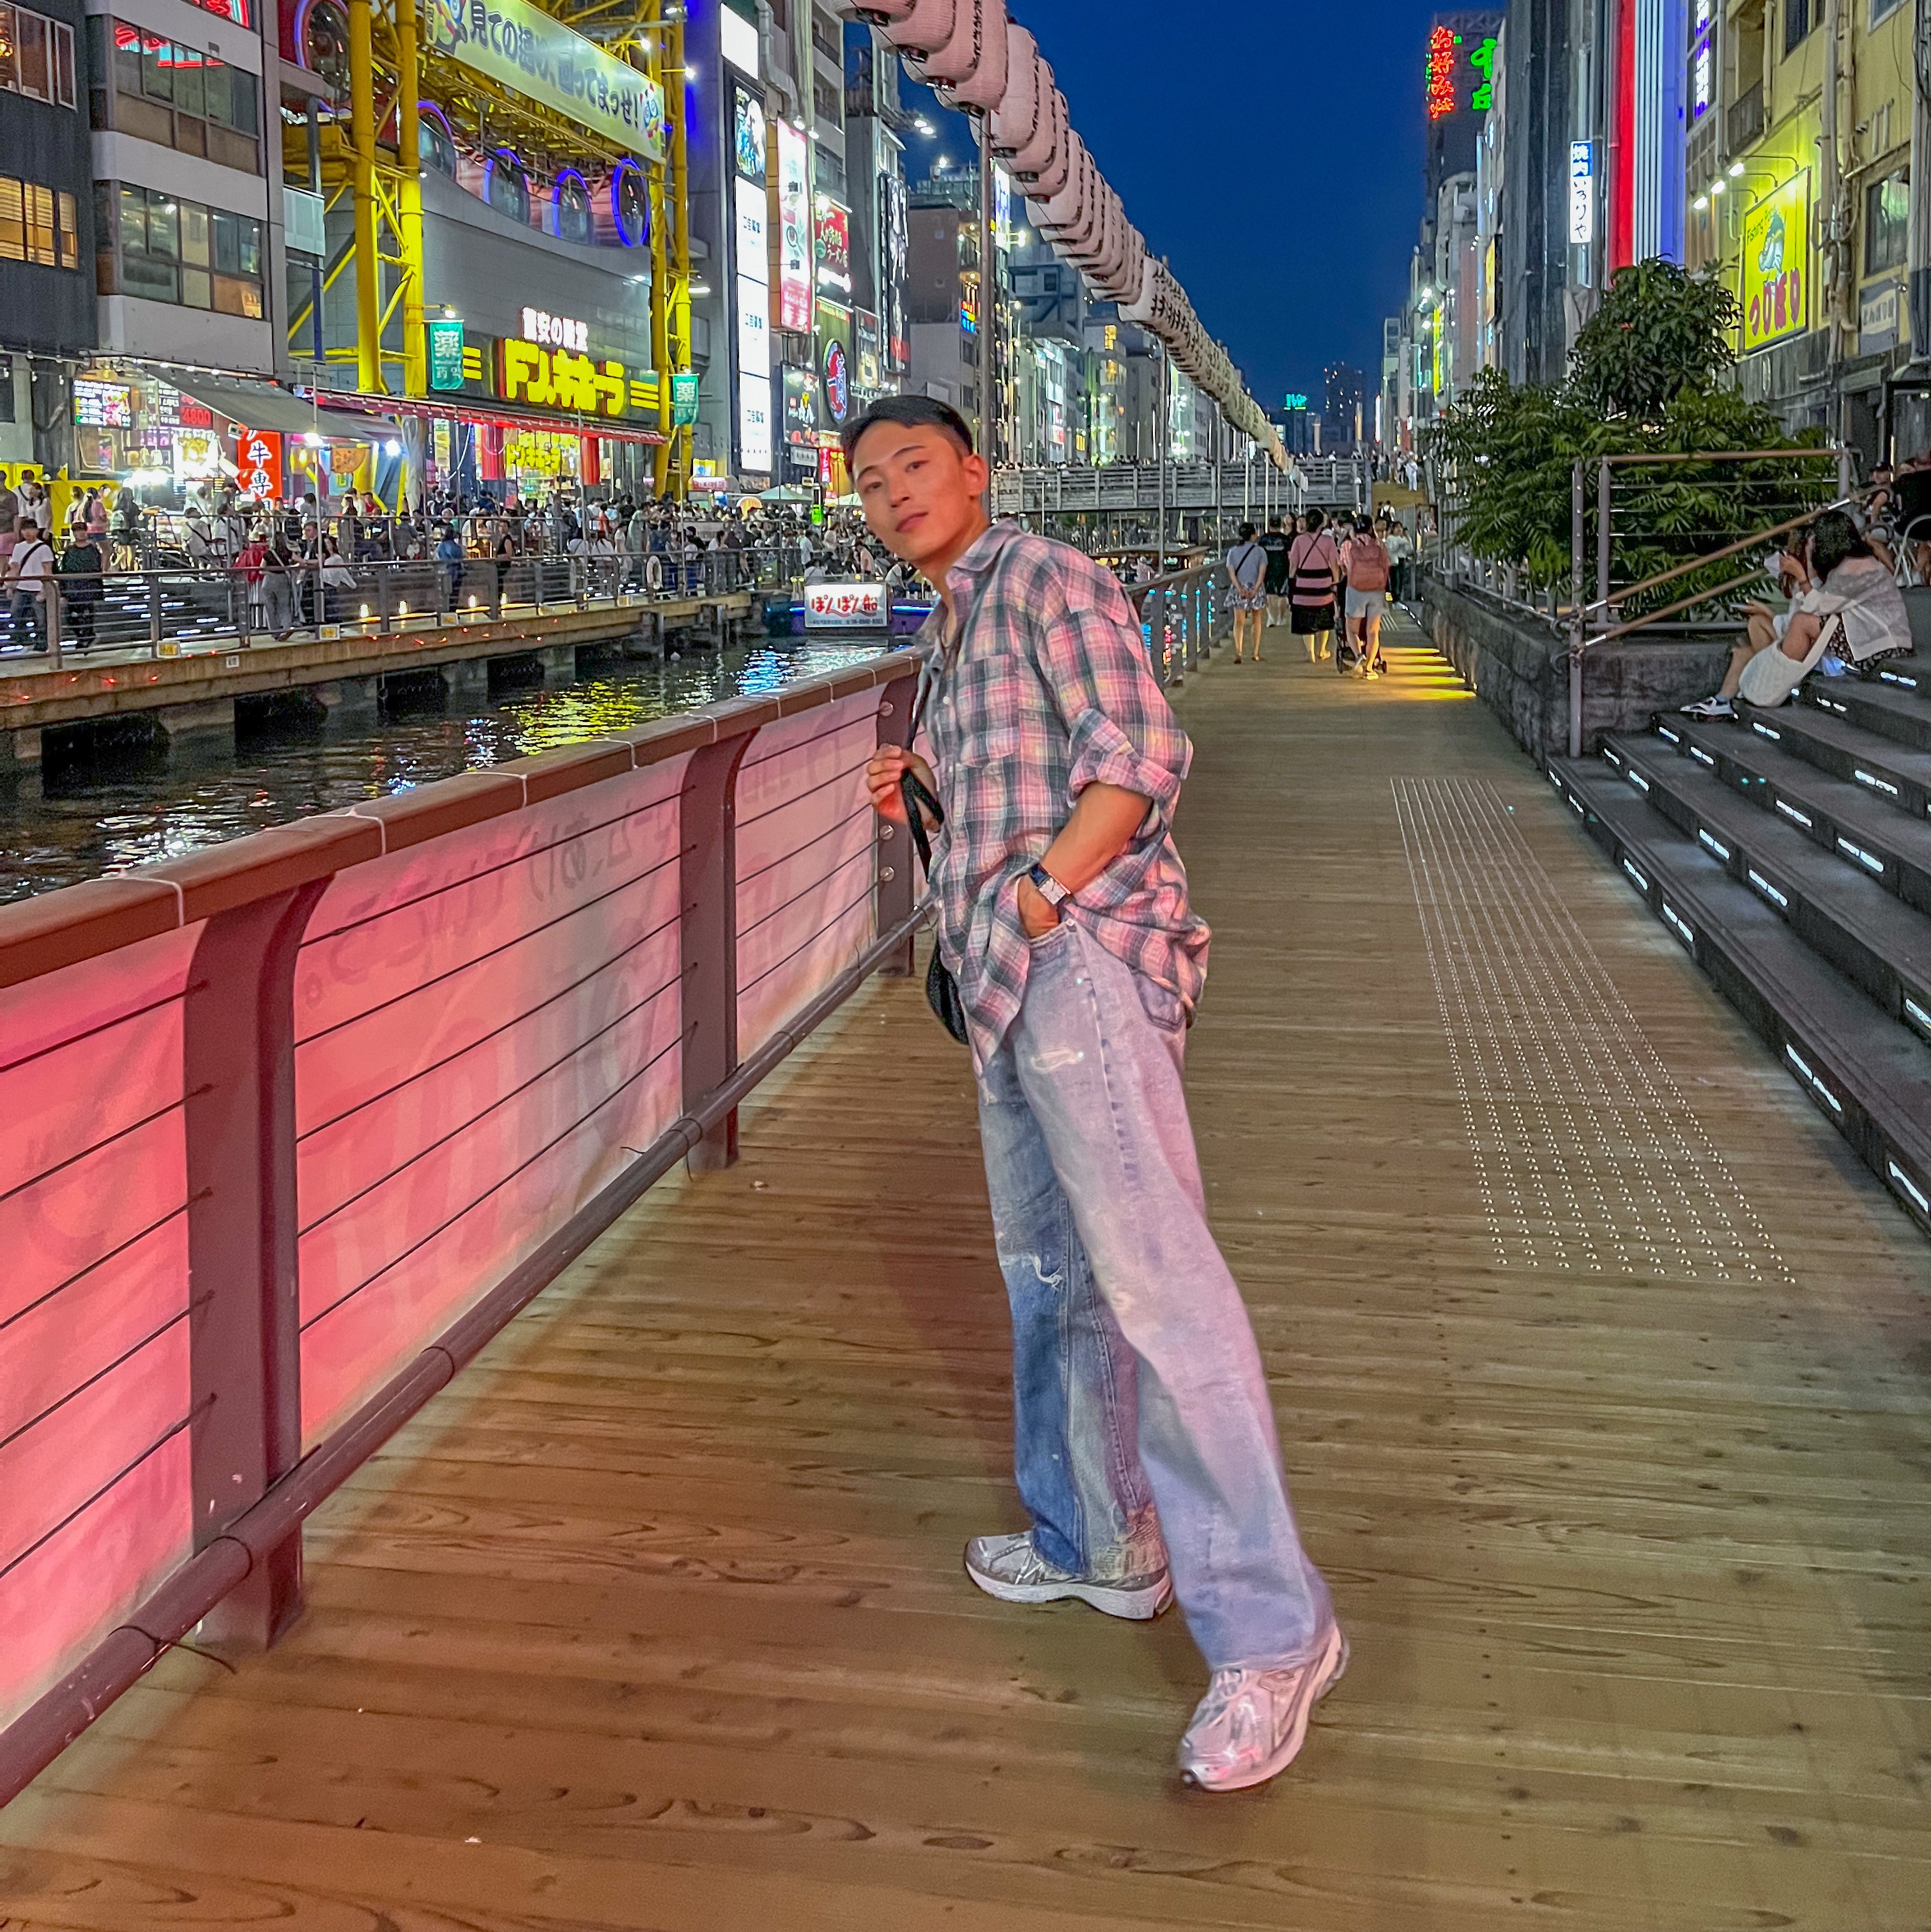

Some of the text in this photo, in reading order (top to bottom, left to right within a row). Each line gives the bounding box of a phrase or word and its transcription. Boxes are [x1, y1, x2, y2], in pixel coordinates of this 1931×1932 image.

[811, 594, 878, 617] ぽんぽん船
